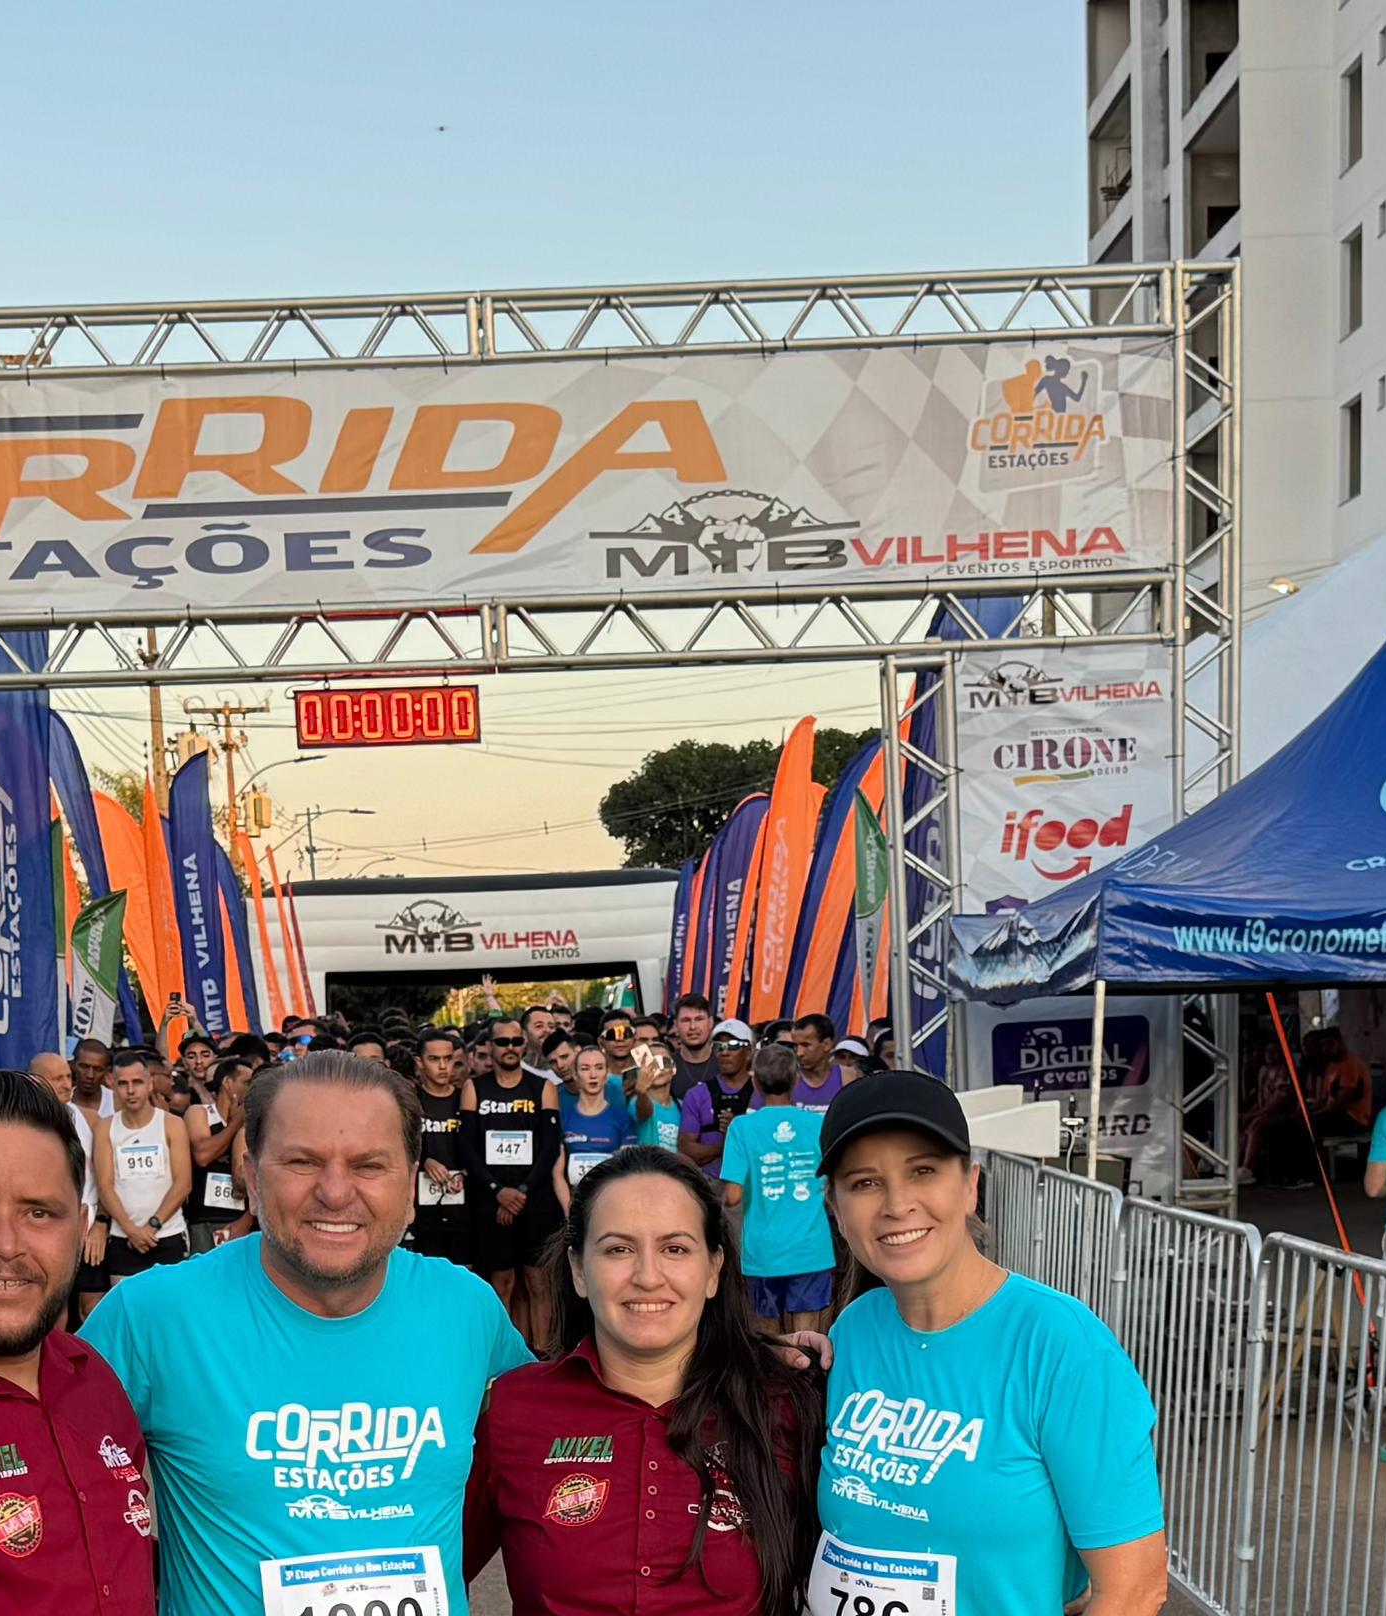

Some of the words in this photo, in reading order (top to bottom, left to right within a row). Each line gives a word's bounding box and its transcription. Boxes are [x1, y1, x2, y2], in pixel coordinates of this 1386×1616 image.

[971, 409, 1106, 462] CORRIDA
[988, 451, 1069, 470] ESTAÇÕES
[606, 538, 849, 579] MTB
[850, 527, 1125, 567] VILHENA
[947, 561, 1020, 575] EVENTOS
[1058, 680, 1162, 702] VILHENA
[299, 690, 475, 741] 00:00:00
[993, 736, 1137, 772] CIRONE
[1097, 765, 1129, 776] DEIRÓ
[5, 822, 22, 998] ESTAÇÕES
[182, 852, 210, 969] VILHENA
[480, 929, 578, 950] VILHENA
[531, 947, 580, 960] EVENTOS
[1044, 1069, 1118, 1084] evenos
[478, 1099, 536, 1115] StarFit
[496, 1143, 521, 1155] 447
[127, 1156, 153, 1169] 916
[214, 1185, 233, 1198] 86
[246, 1402, 446, 1480] CORRIDA
[548, 1435, 613, 1458] NIVEL
[831, 1389, 986, 1485] CORRIDA
[832, 1443, 920, 1487] ESTAÇÕES
[274, 1463, 395, 1497] ESTAÇÕES
[349, 1504, 415, 1519] VILHENA
[321, 1565, 353, 1576] Corrida
[383, 1560, 416, 1572] Estações
[890, 1563, 928, 1577] Estações
